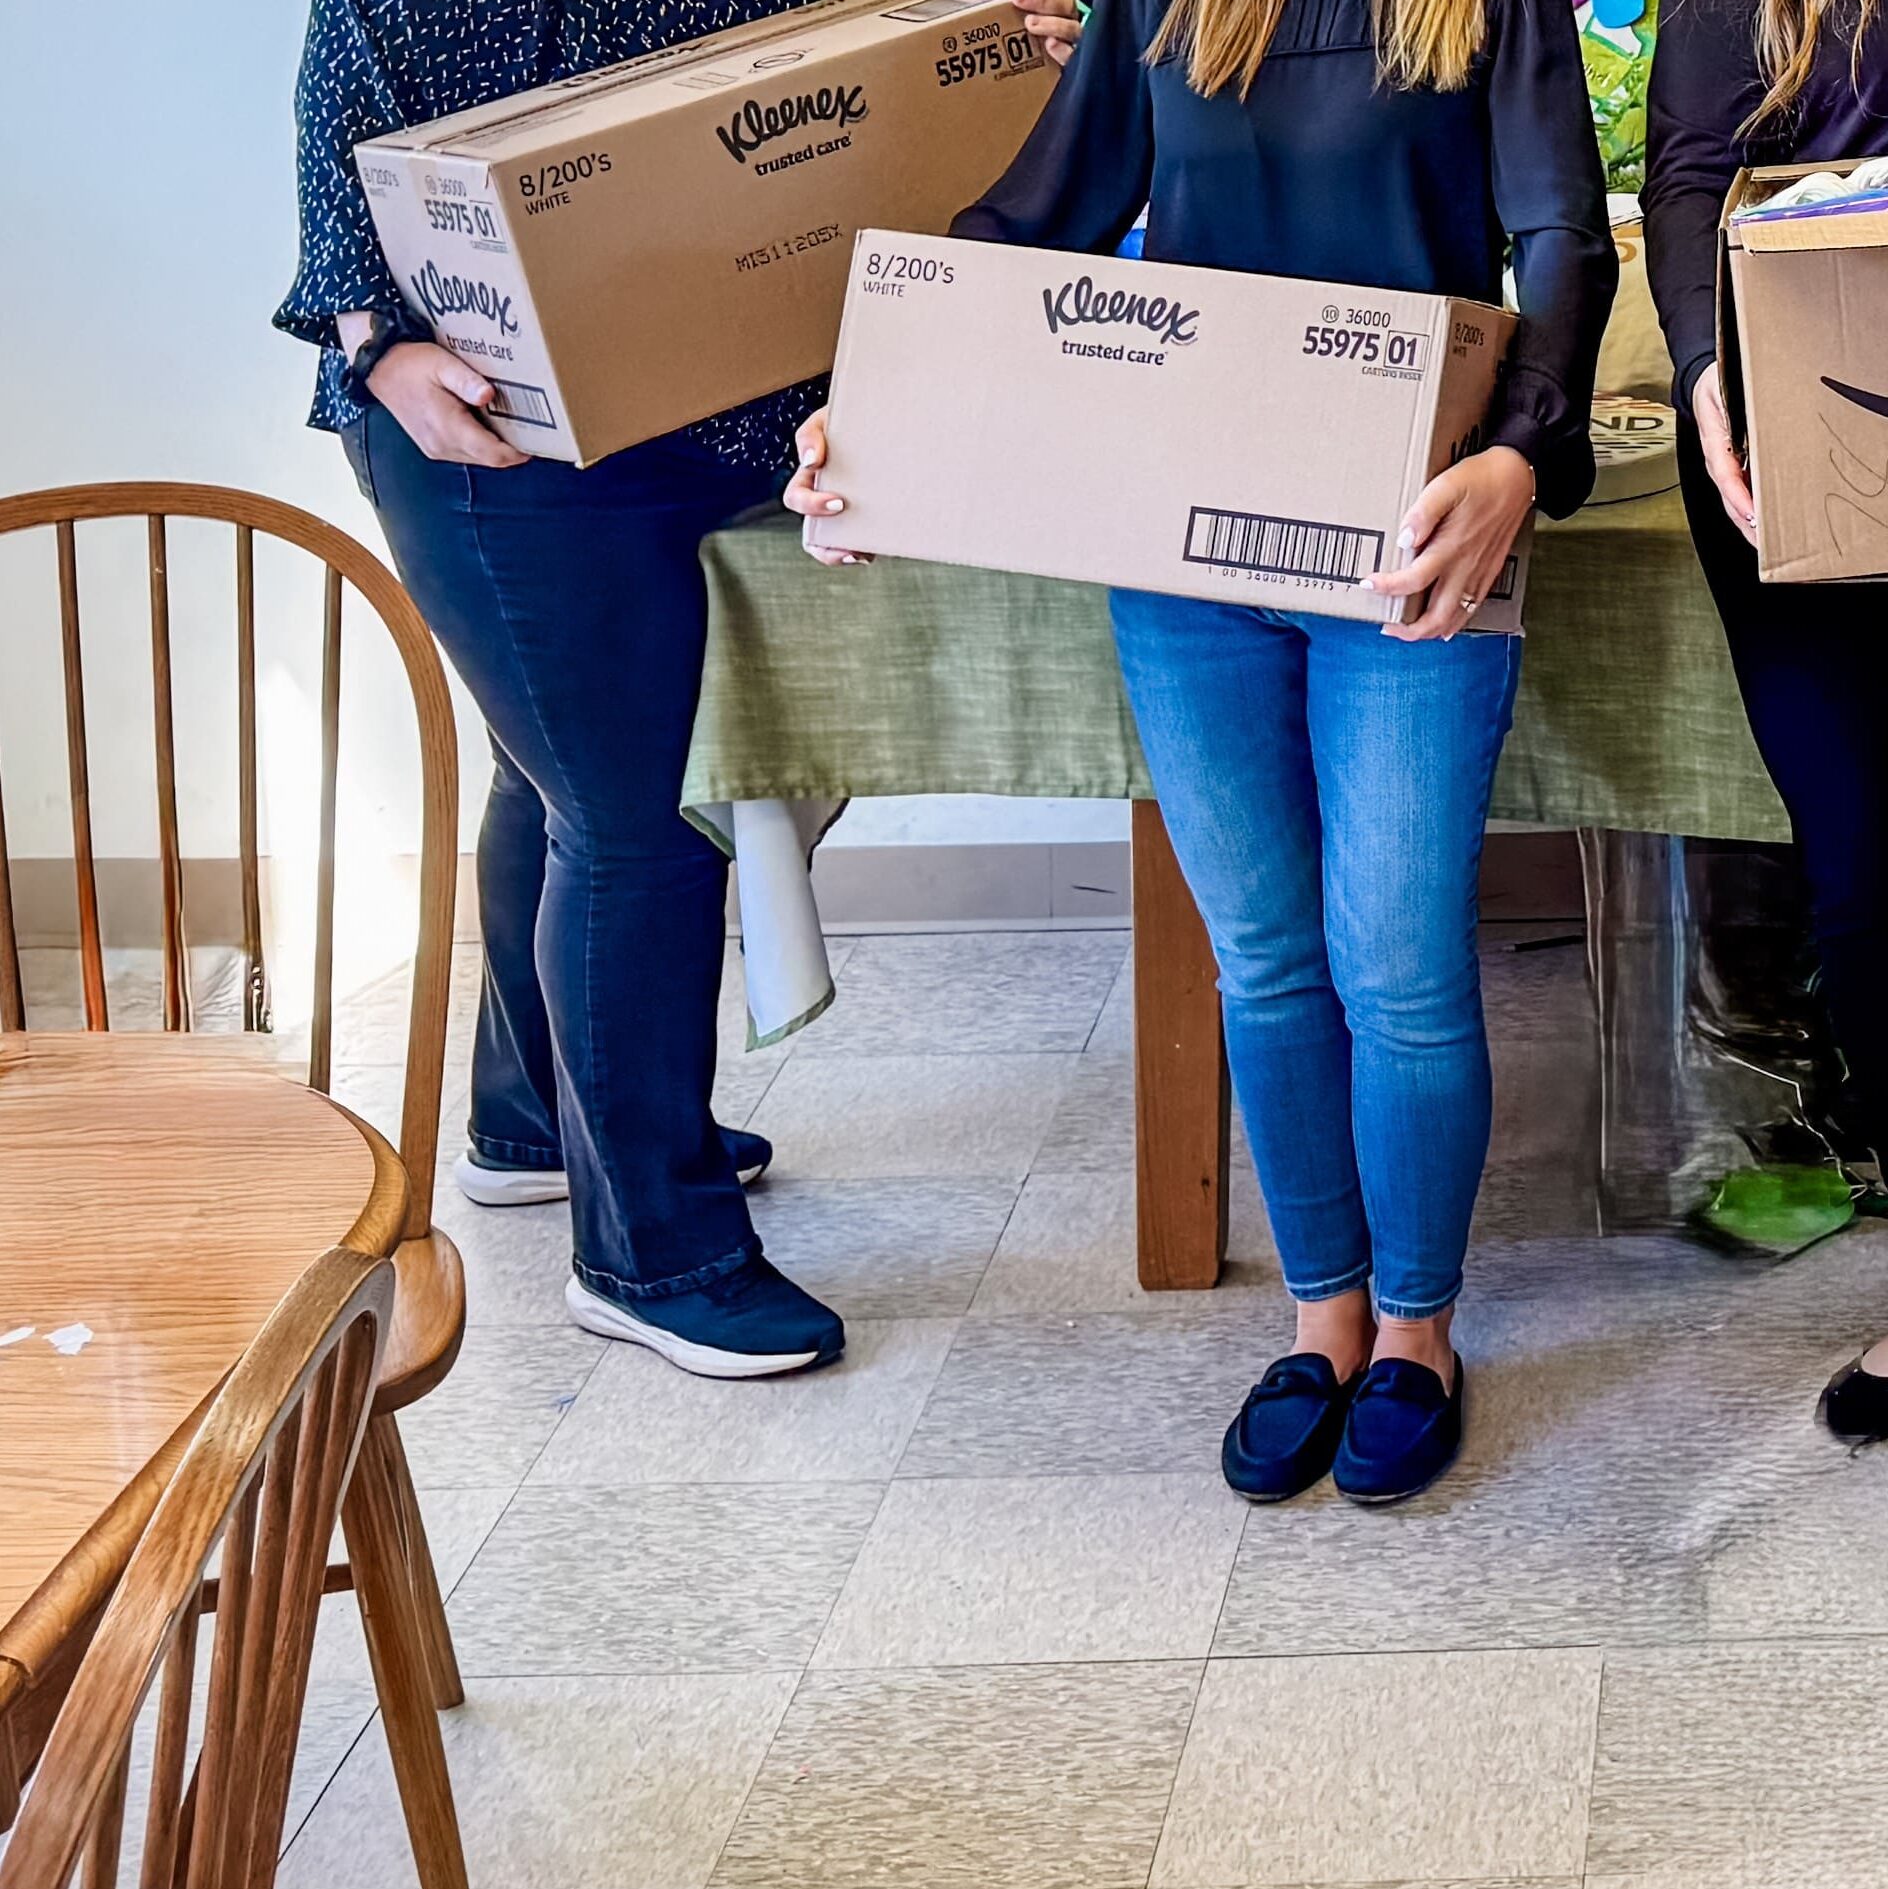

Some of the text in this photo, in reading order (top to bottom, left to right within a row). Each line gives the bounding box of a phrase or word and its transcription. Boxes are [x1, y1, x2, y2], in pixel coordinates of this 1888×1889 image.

[935, 42, 1003, 88] 55975
[1007, 32, 1034, 63] 01
[716, 85, 867, 164] Kleenex
[754, 133, 852, 176] trusted care
[519, 152, 612, 198] 8/200's
[424, 198, 498, 238] 55975 01
[525, 191, 572, 217] WHITE
[866, 253, 955, 284] 8/200's
[411, 259, 518, 337] Kleenex
[862, 280, 906, 298] WHITE
[1042, 276, 1200, 344] Kleenex
[1345, 308, 1391, 328] 36000
[446, 334, 514, 362] trusted care
[1062, 339, 1166, 366] trusted care
[1302, 326, 1418, 367] 55975 01
